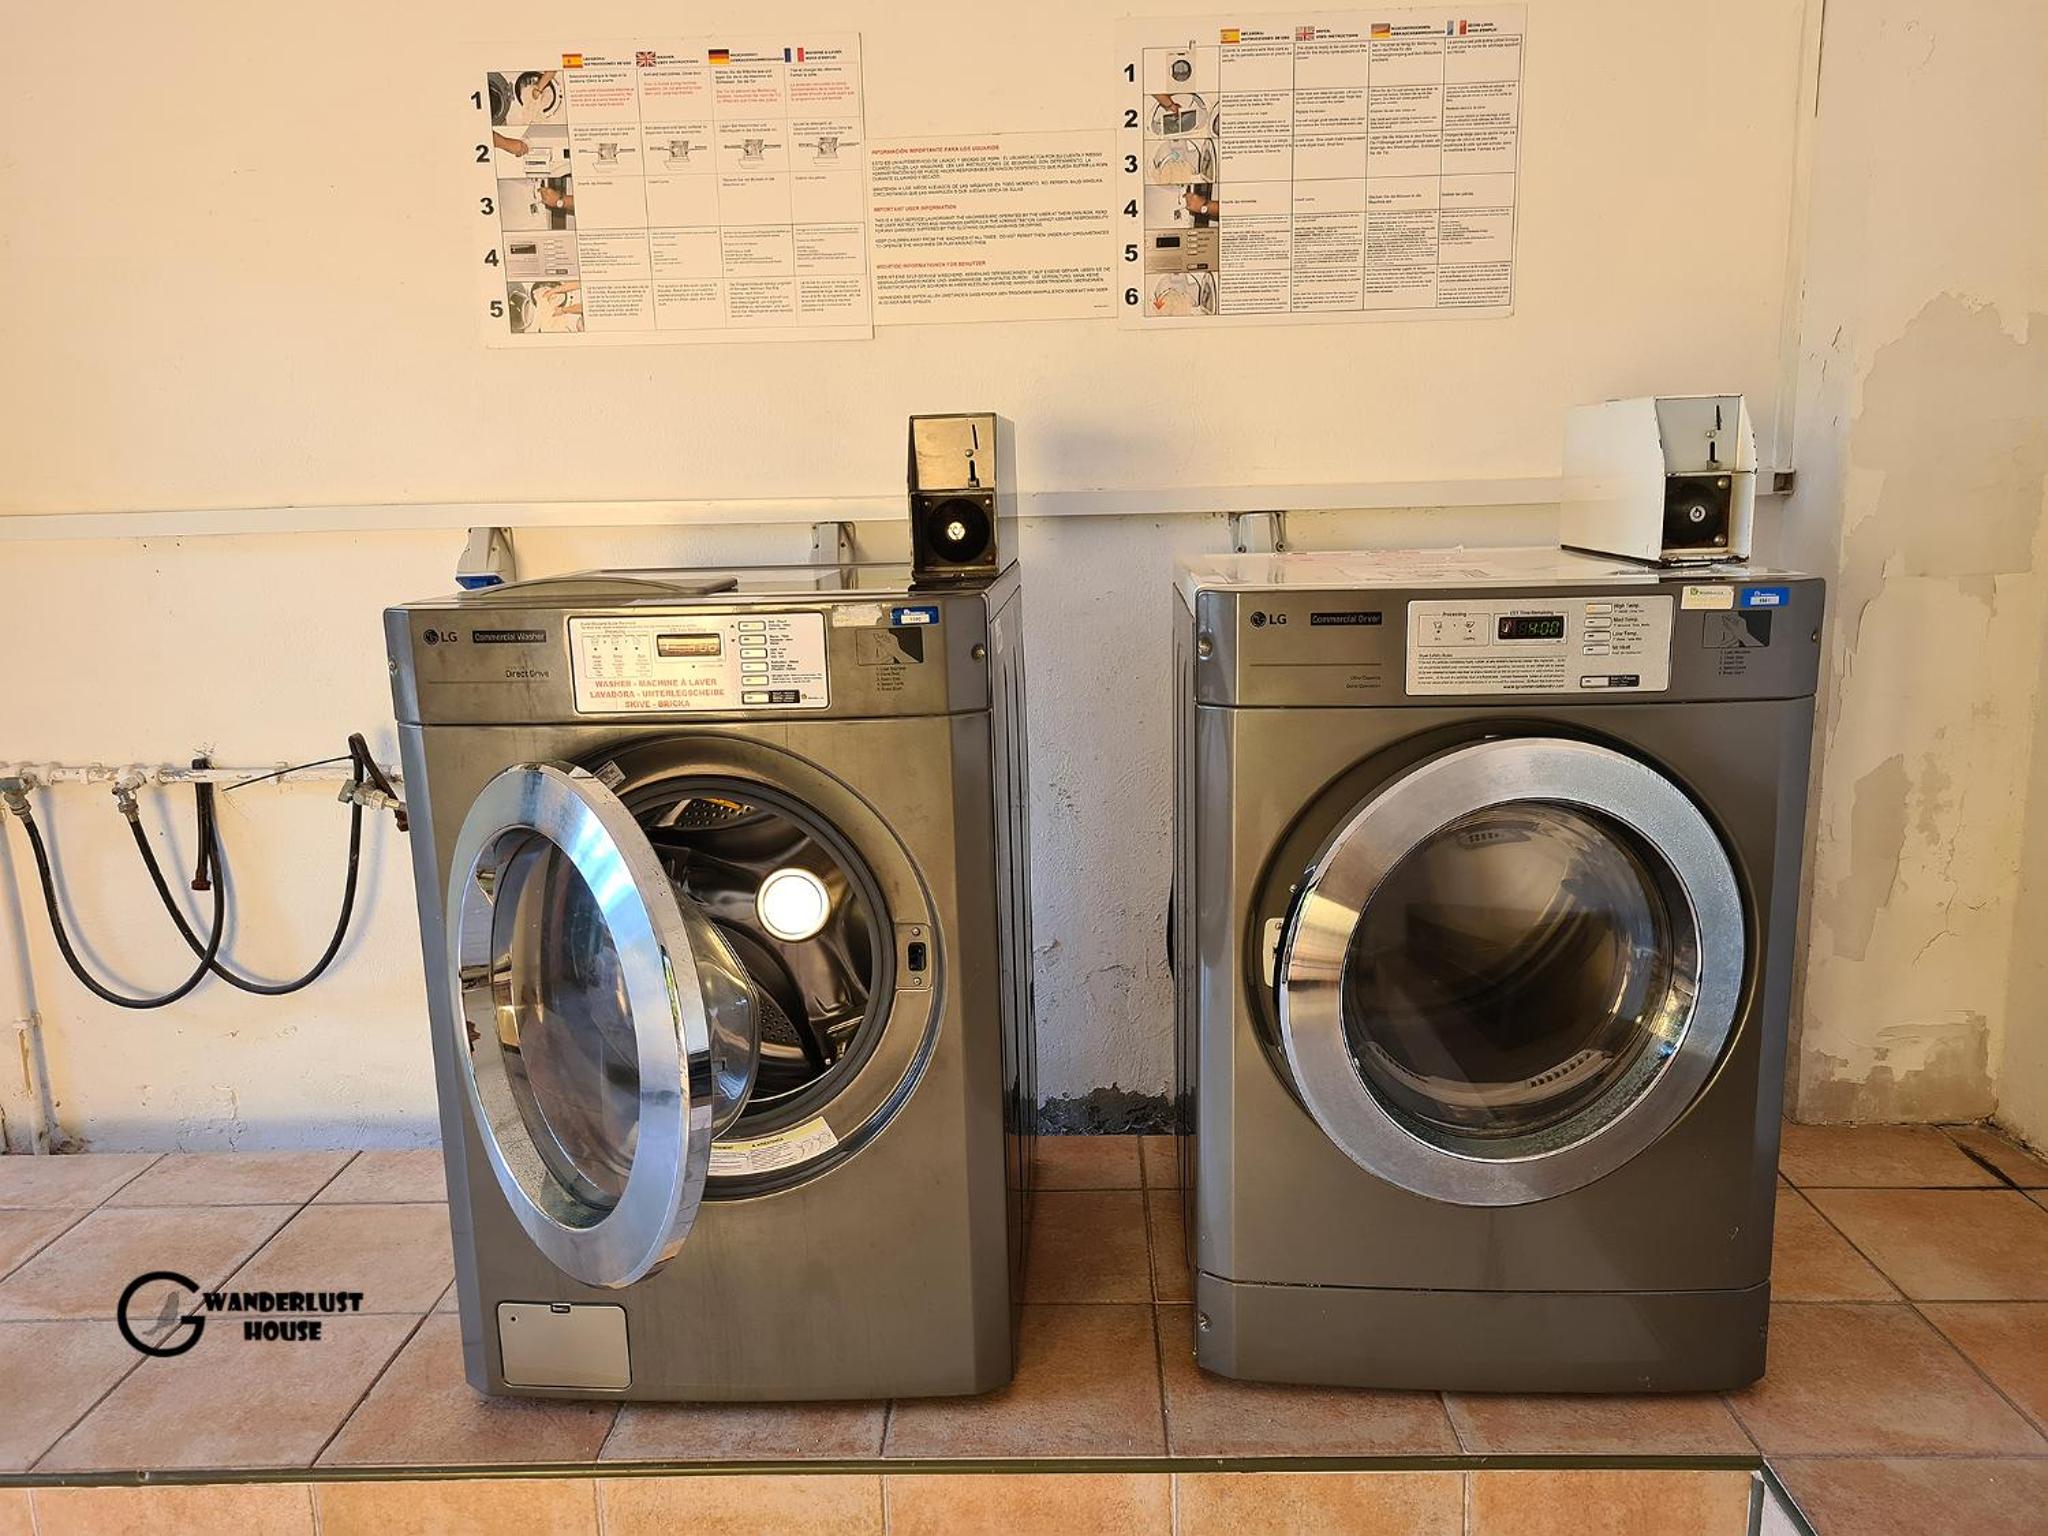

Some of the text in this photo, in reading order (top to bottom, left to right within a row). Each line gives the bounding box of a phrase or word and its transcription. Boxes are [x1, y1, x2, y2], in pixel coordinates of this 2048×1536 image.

[1124, 64, 1134, 82] 1
[471, 91, 482, 109] 1
[1124, 110, 1138, 127] 2
[476, 145, 490, 163] 2
[1124, 155, 1137, 172] 3
[481, 198, 494, 215] 3
[1124, 200, 1138, 217] 4
[484, 249, 498, 266] 4
[1124, 244, 1138, 261] 5
[1124, 288, 1138, 305] 6
[490, 301, 503, 317] 5
[1270, 614, 1286, 624] LG
[1312, 614, 1380, 625] Commercial Dryer
[442, 633, 458, 642] LG
[474, 631, 544, 642] Commercial Washer
[530, 669, 549, 677] Drive
[682, 678, 686, 686] À
